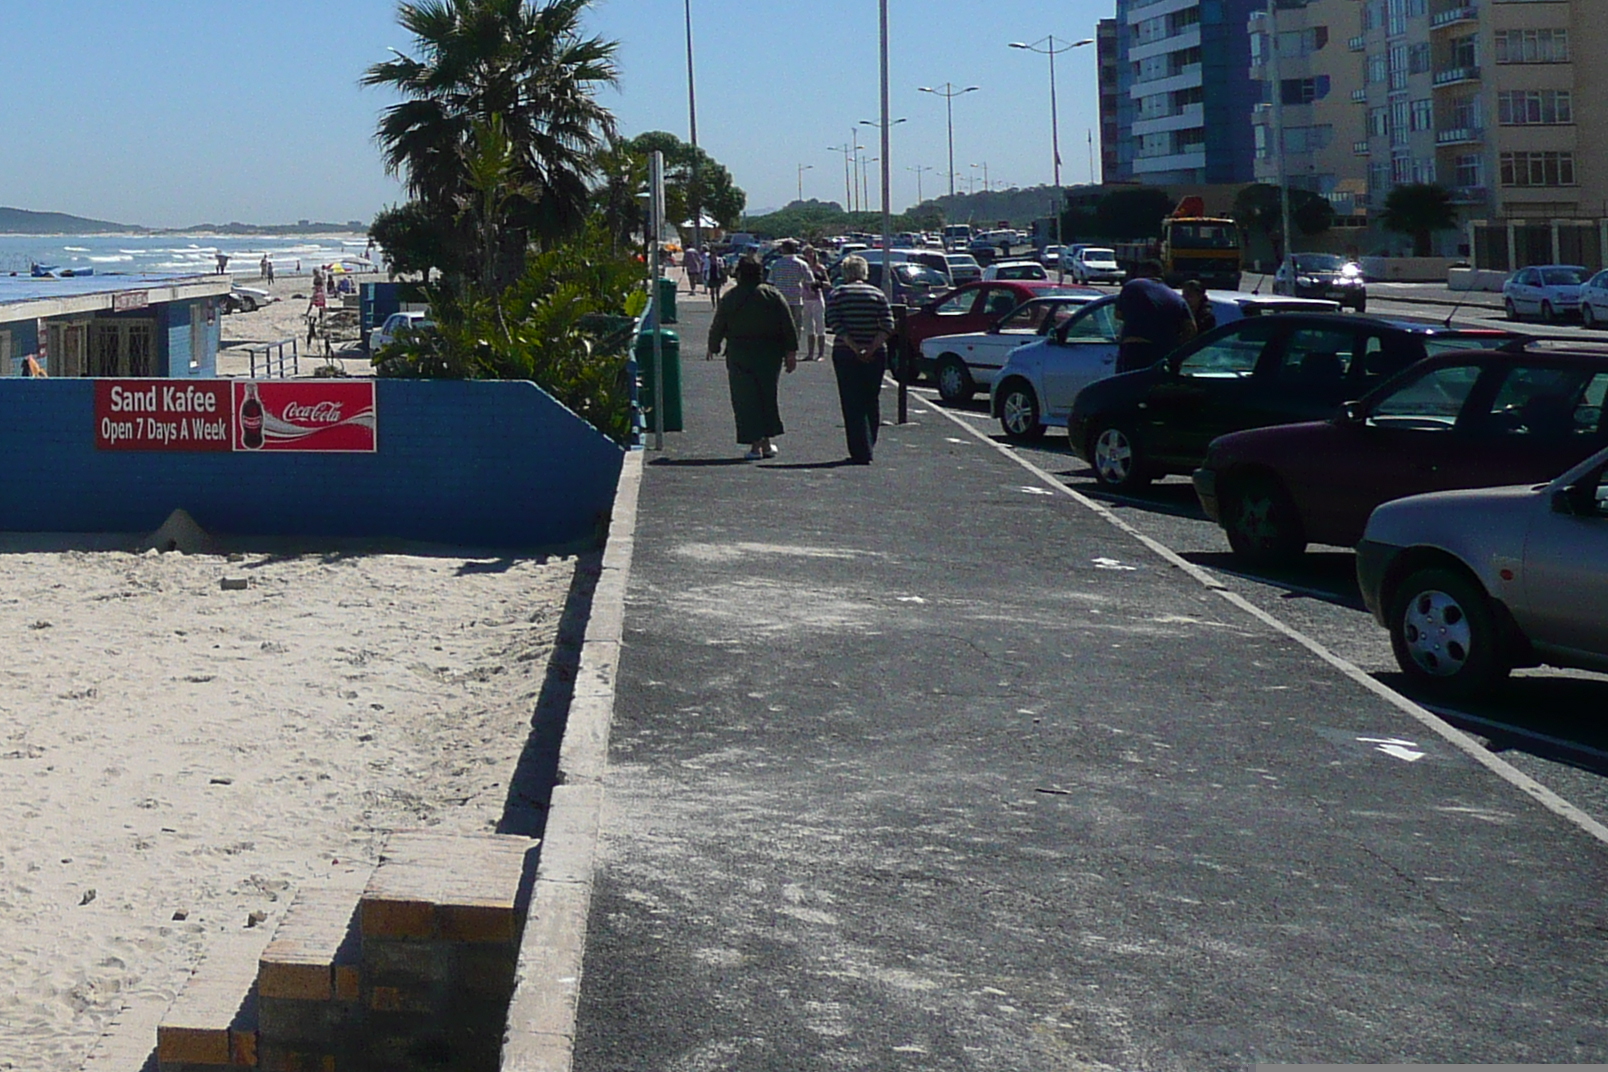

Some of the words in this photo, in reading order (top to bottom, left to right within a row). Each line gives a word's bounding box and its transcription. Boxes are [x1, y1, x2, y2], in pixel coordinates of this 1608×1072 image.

[111, 385, 157, 412] Sand
[163, 385, 216, 412] Kafee
[101, 417, 133, 445] Open
[136, 417, 144, 440] 7
[147, 417, 177, 445] Days
[180, 417, 189, 440] A
[192, 417, 227, 440] Week
